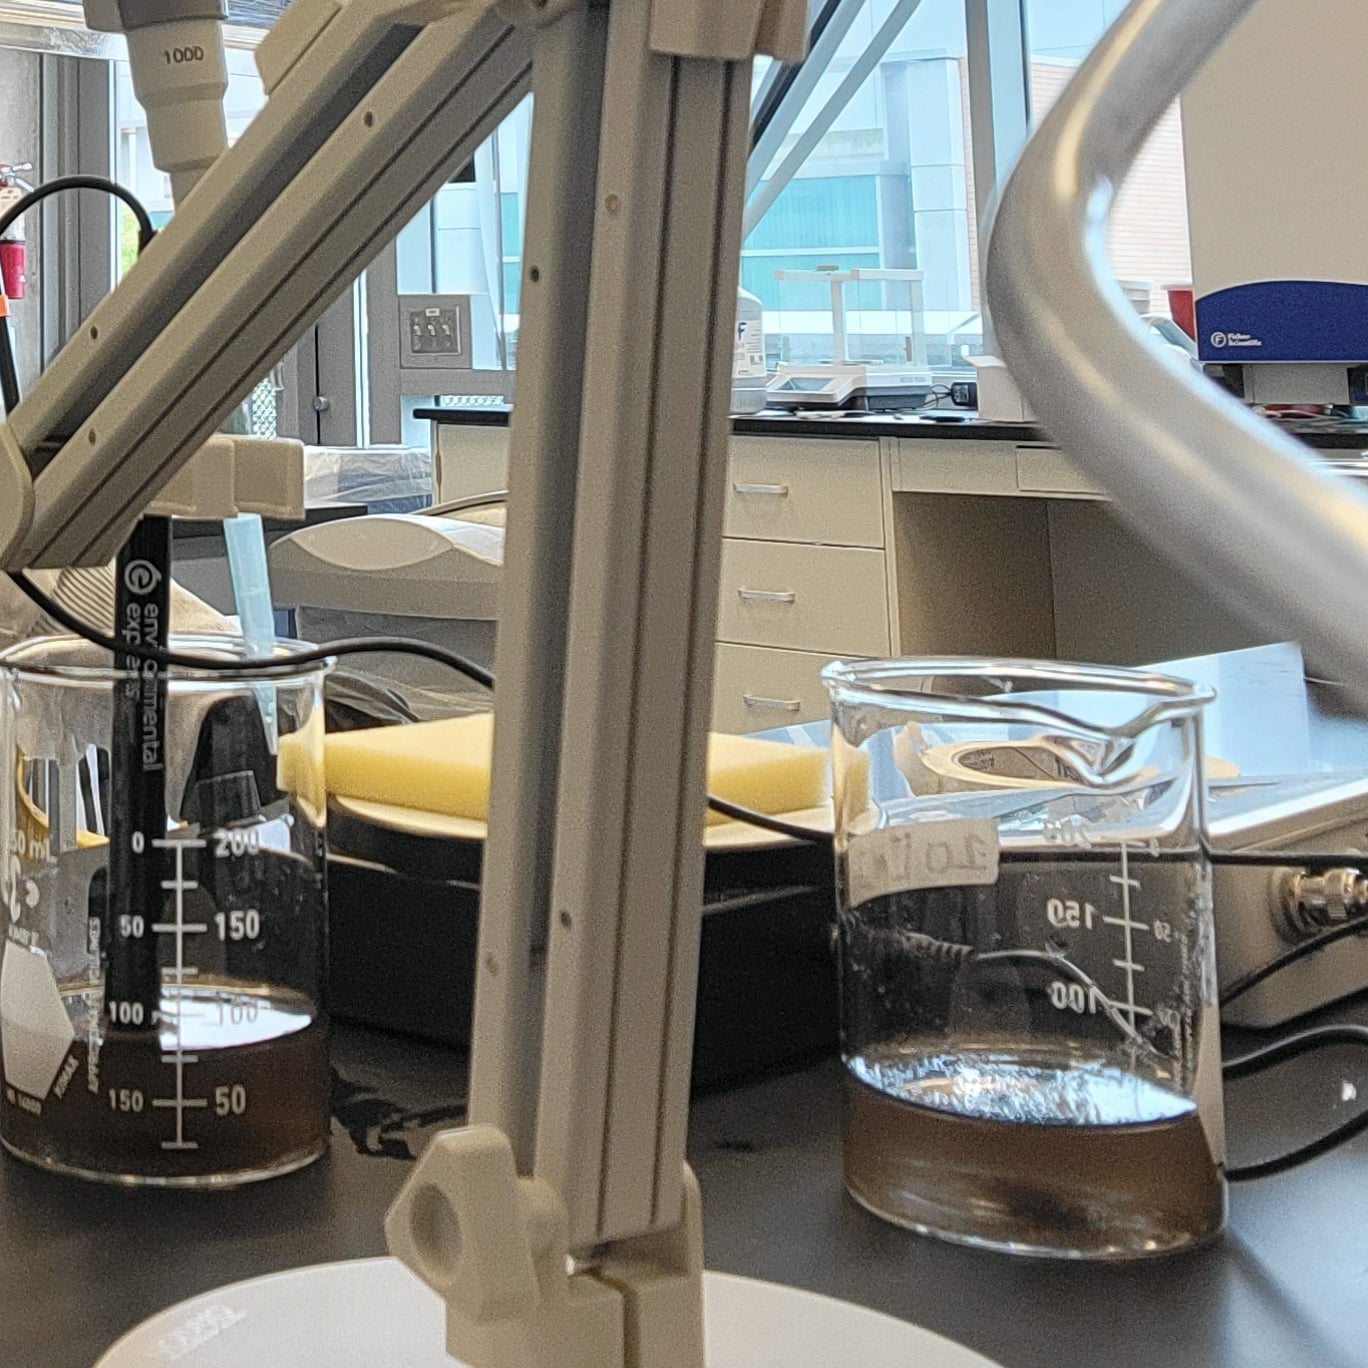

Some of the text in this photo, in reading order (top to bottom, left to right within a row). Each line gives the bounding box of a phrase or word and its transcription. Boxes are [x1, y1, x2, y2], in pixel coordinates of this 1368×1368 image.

[164, 45, 205, 65] 1000
[131, 831, 145, 855] 0
[118, 909, 261, 942] 50 150
[108, 1000, 259, 1027] 100 100
[108, 1084, 248, 1118] 150 50
